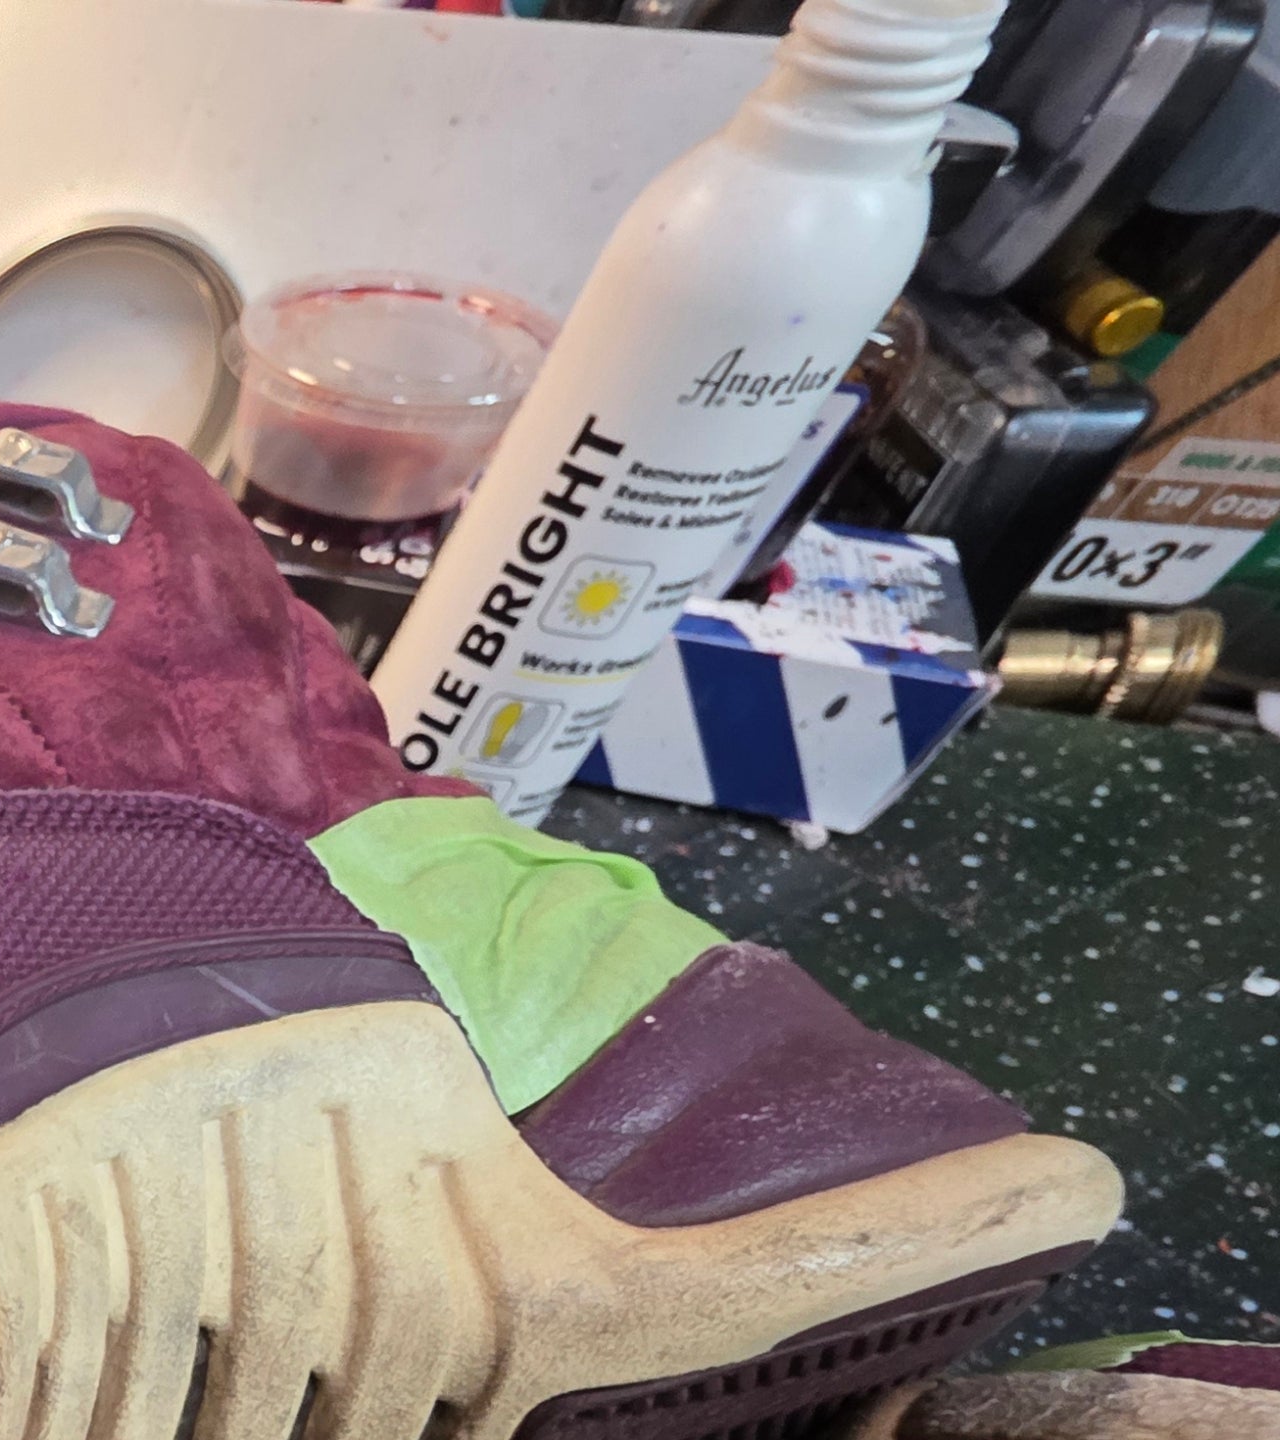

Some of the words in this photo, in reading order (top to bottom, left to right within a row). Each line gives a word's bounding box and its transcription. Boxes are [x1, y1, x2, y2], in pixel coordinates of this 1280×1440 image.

[677, 346, 836, 407] Angelus
[400, 669, 481, 774] OLE
[454, 413, 625, 669] BRIGHT
